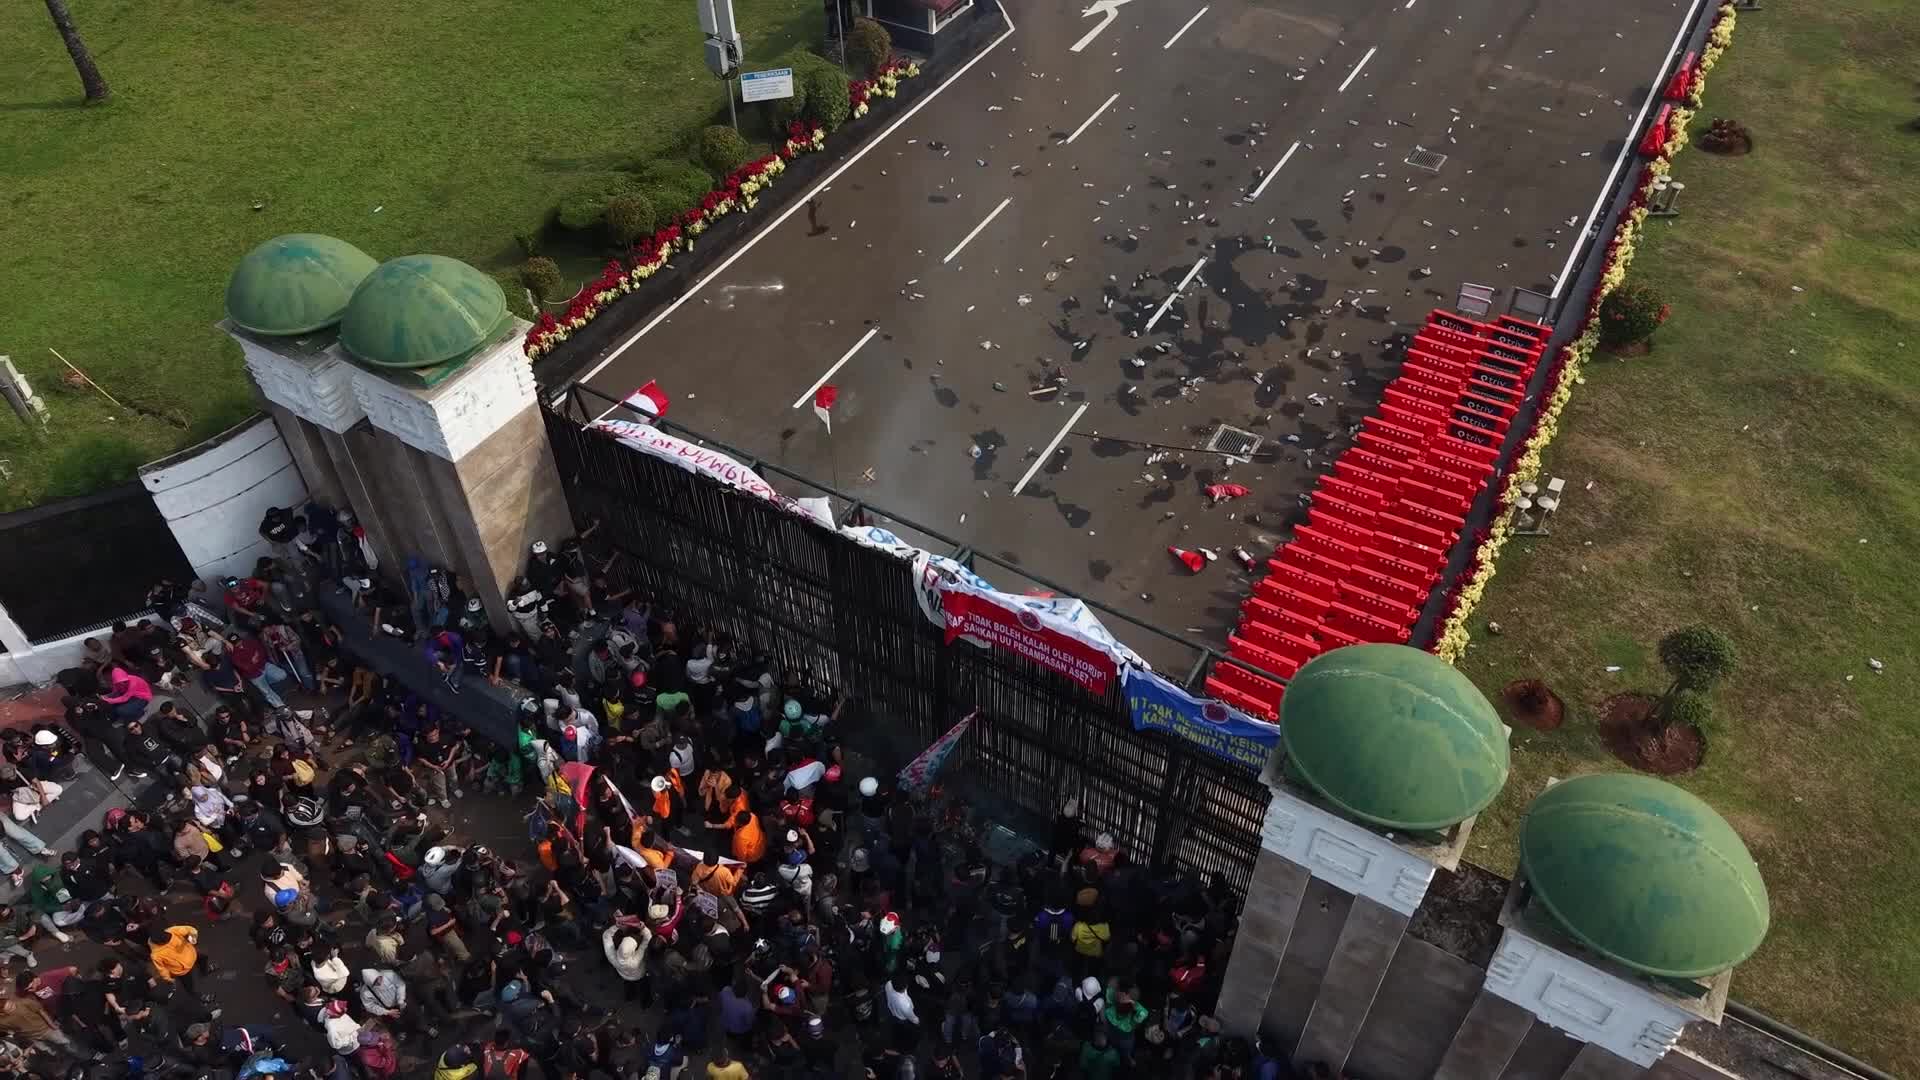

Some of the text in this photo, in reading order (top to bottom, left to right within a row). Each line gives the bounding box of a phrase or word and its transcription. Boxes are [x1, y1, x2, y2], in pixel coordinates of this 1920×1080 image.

[1475, 403, 1494, 414] triv
[1469, 417, 1487, 428] triv
[1465, 432, 1484, 444] triv
[967, 611, 992, 629] TIDAK
[993, 621, 1021, 639] BOLEH
[1022, 635, 1050, 654] KALAH
[1052, 648, 1074, 666] OLEH
[963, 622, 998, 641] SAHKAN
[999, 636, 1012, 646] UU
[1013, 640, 1067, 672] PERAMPASAN
